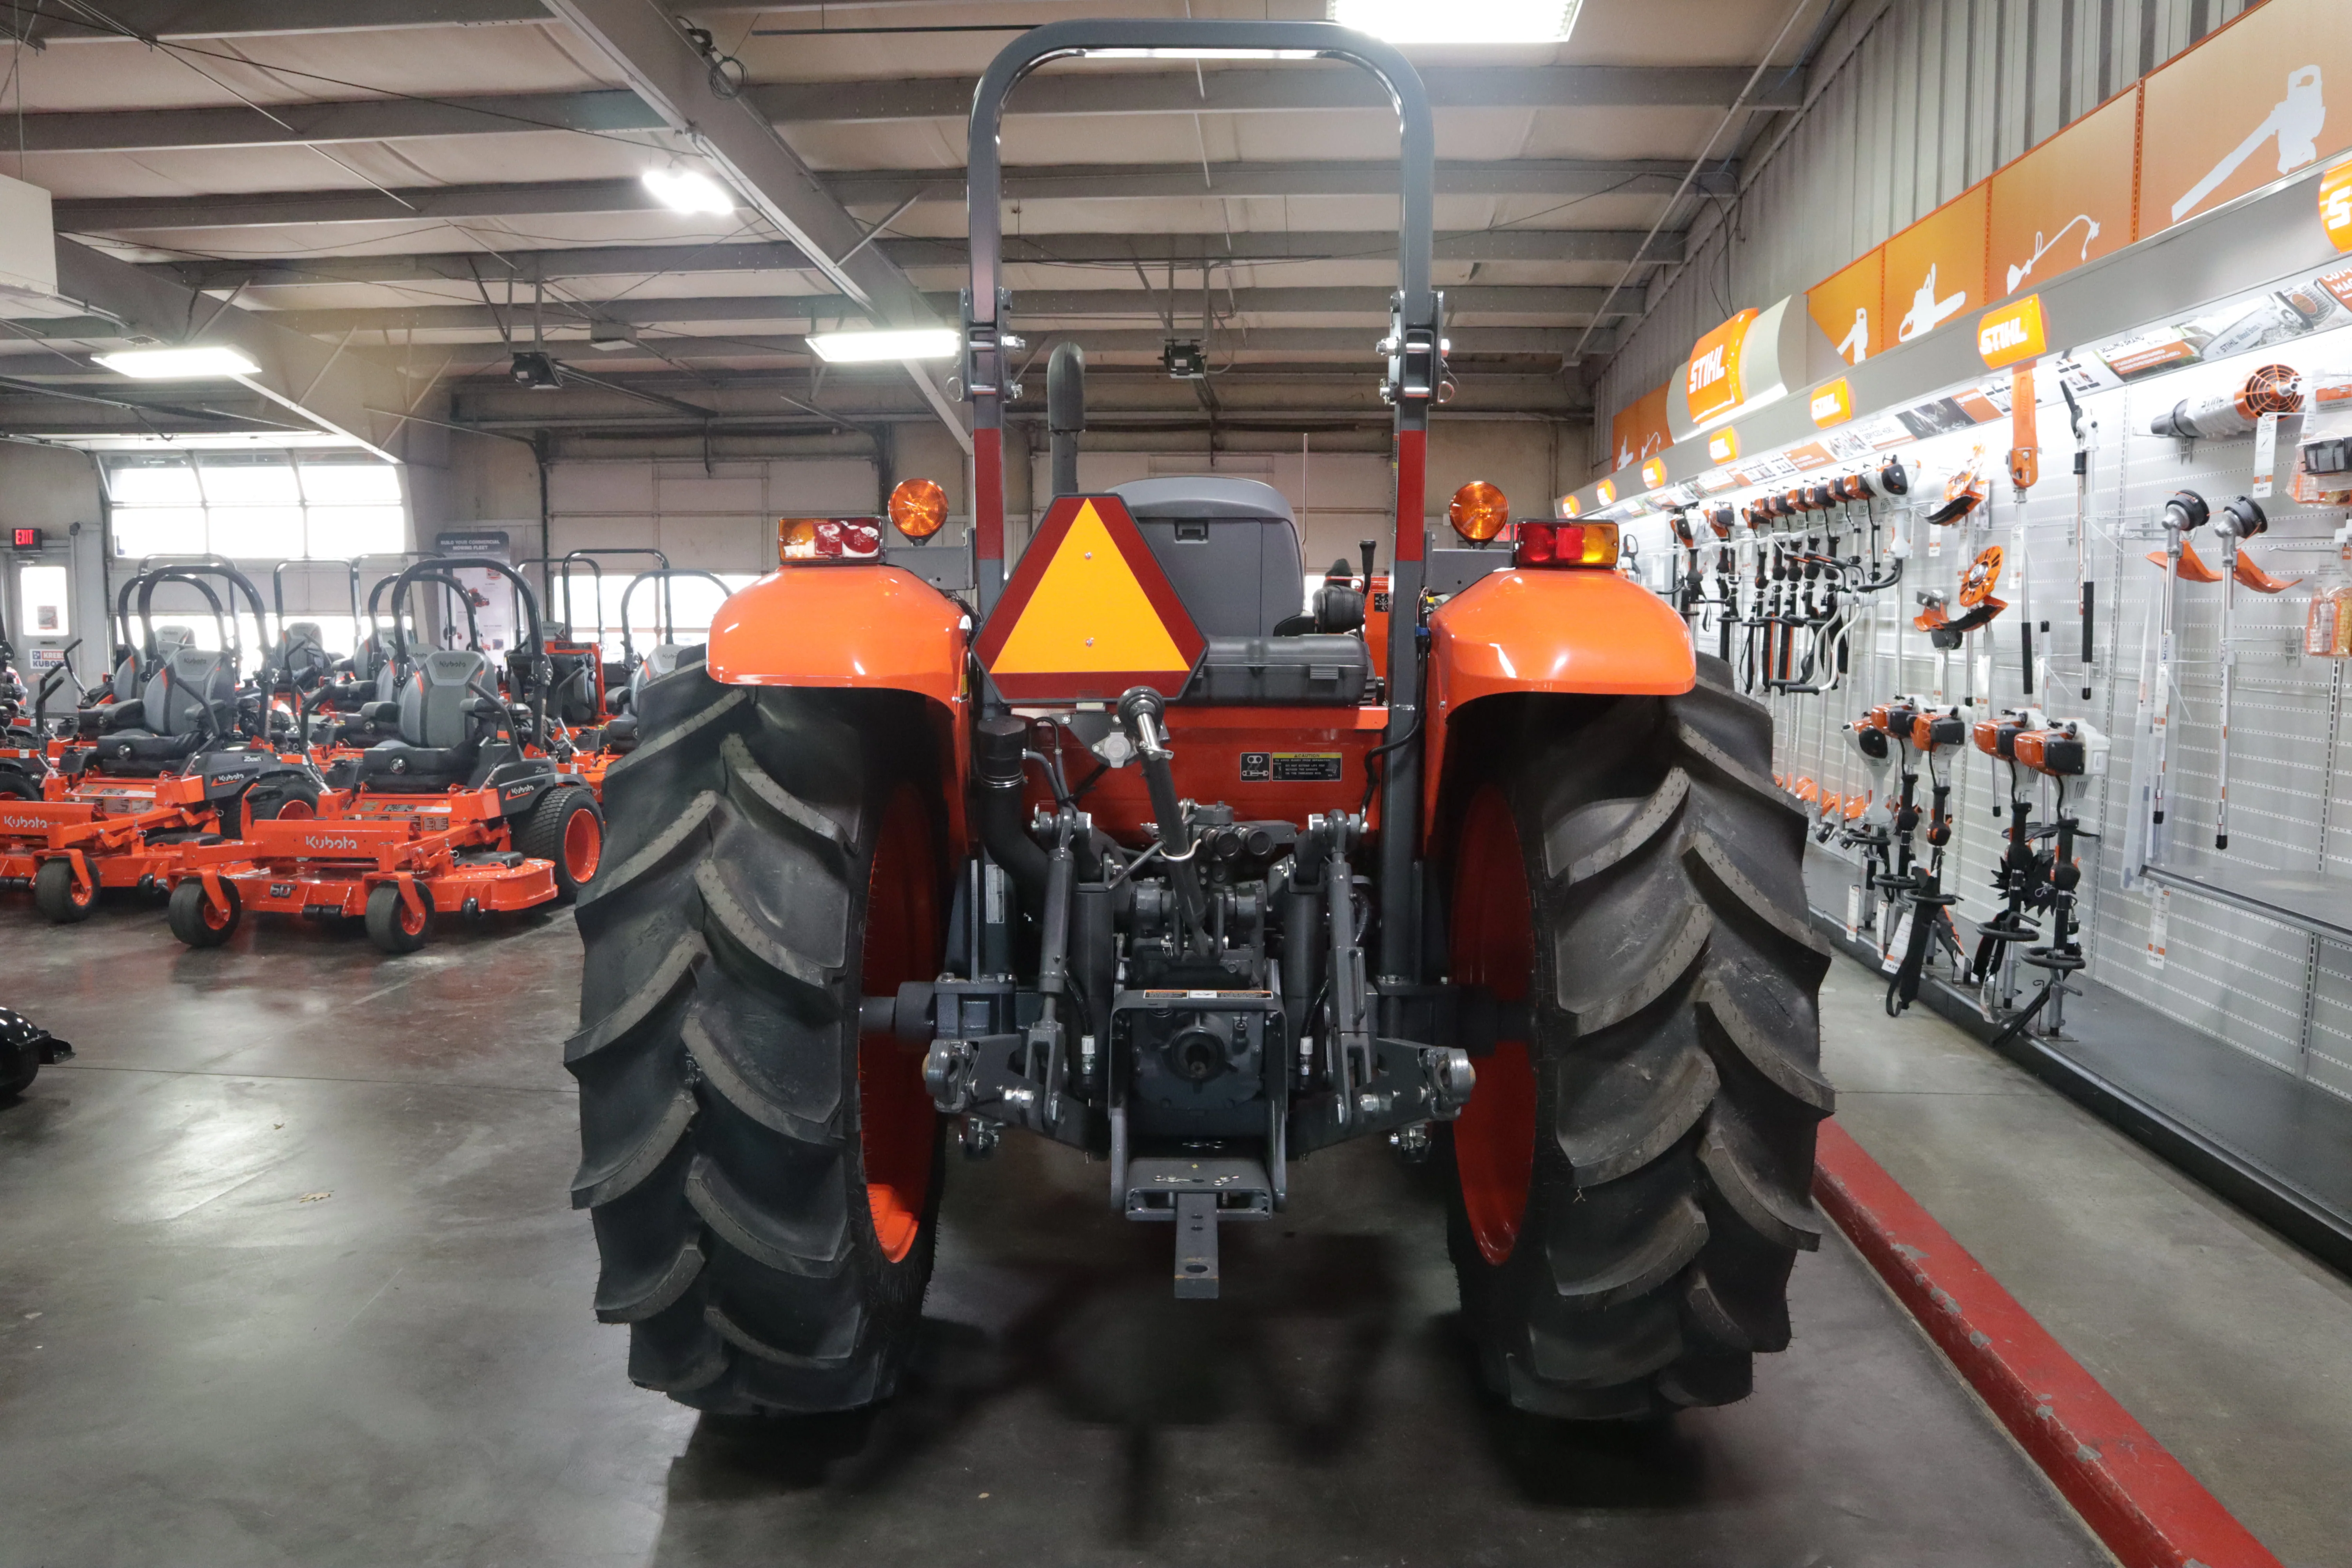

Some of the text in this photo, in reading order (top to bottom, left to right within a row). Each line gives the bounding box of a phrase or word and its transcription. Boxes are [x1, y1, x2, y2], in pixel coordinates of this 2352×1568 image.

[2328, 185, 2352, 230] S
[1979, 317, 2027, 355] STIHL
[2220, 338, 2239, 353] STIHL
[1689, 344, 1725, 394] STIHL
[15, 529, 34, 545] EXIT
[218, 773, 245, 781] Kubota
[511, 784, 535, 795] Kubota
[4, 815, 47, 828] Kubota
[305, 835, 357, 849] Kubota
